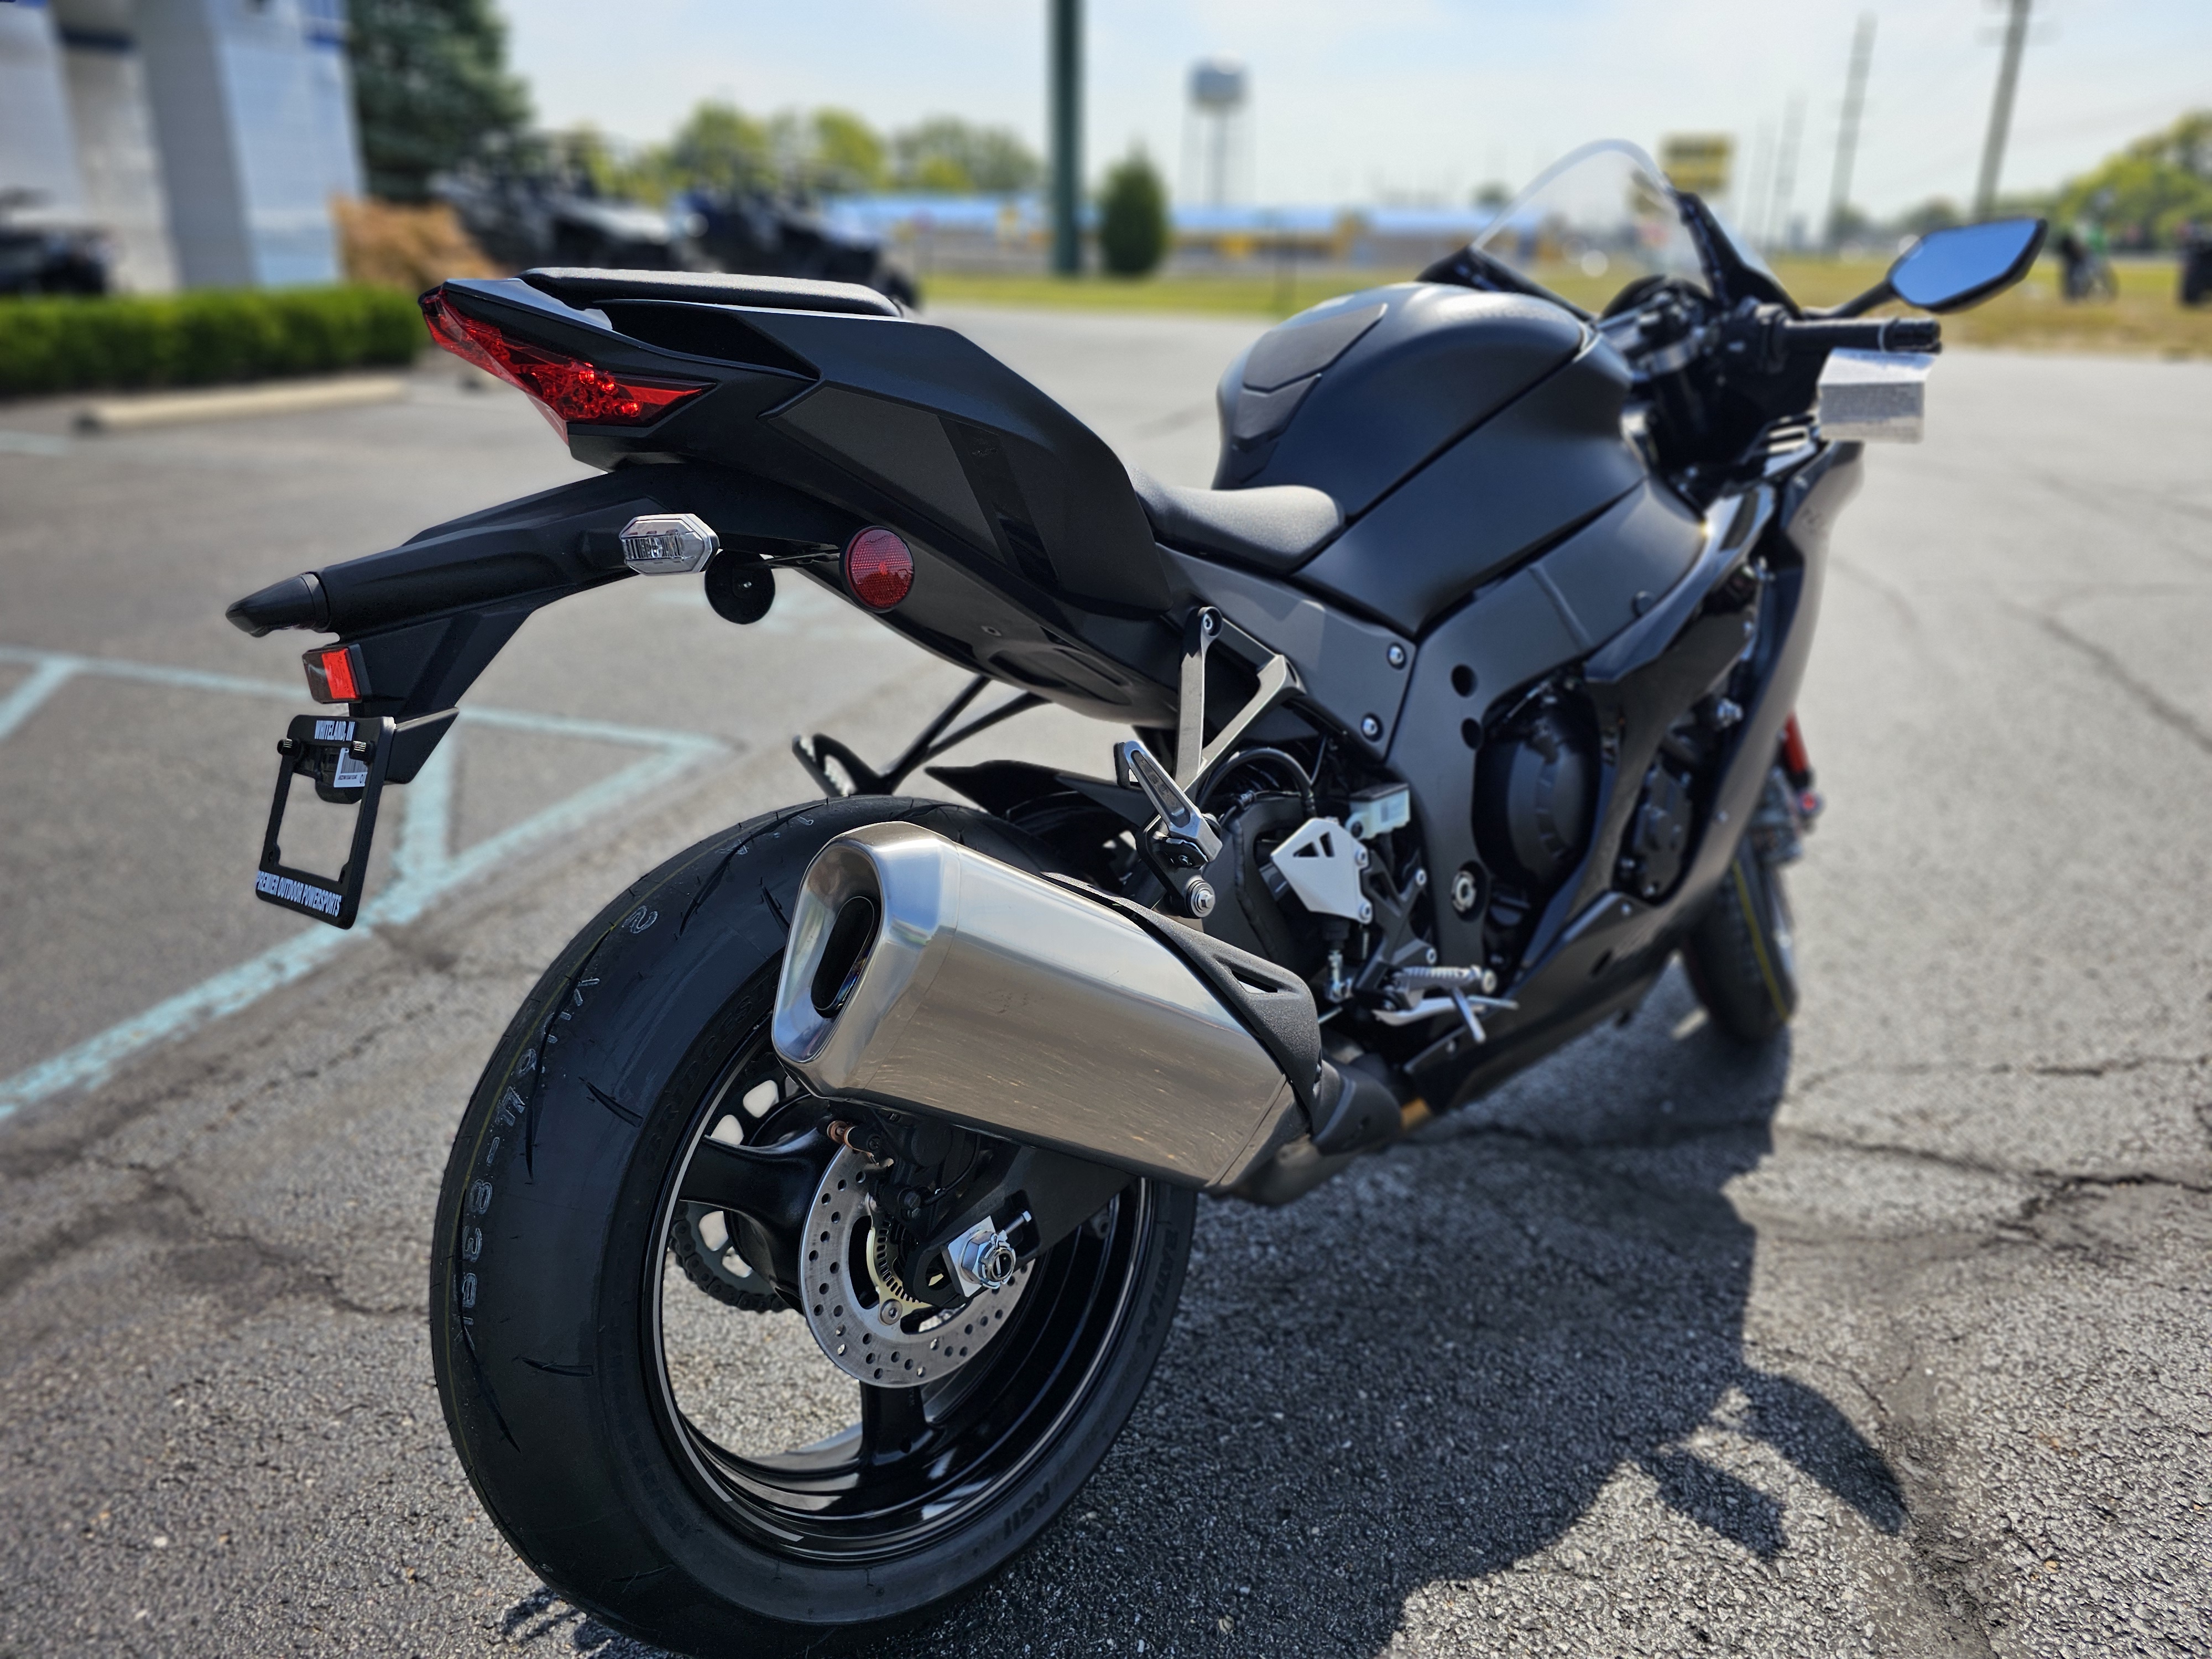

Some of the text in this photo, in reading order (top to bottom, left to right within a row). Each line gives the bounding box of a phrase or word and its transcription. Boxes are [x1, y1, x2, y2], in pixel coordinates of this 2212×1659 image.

[256, 870, 342, 917] PREMIER OUTDOOR POWERSPORTS
